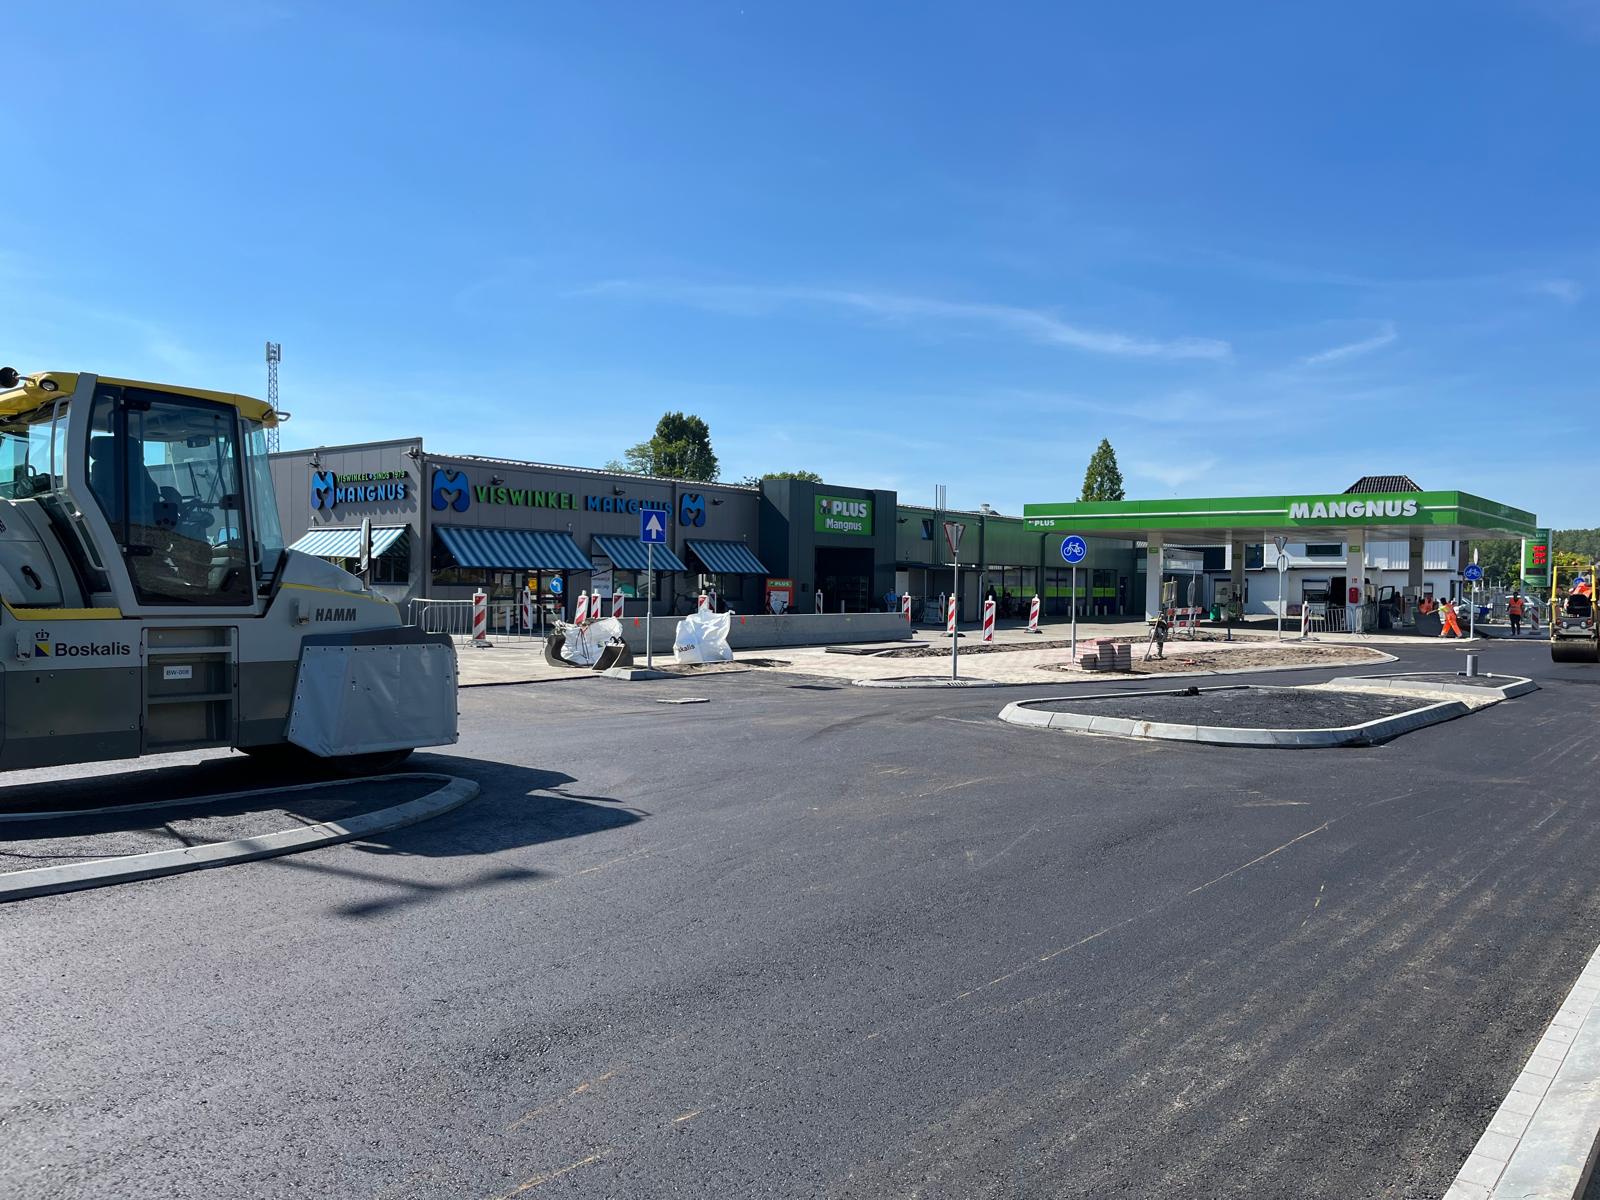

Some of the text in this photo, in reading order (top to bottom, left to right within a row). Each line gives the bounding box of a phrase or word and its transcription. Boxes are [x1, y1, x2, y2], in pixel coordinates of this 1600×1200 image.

[336, 473, 369, 483] VISWINKEL
[336, 482, 405, 503] MANGNUS
[475, 484, 579, 511] VISWINKEL
[831, 500, 868, 518] PLUS
[1289, 499, 1418, 519] MANGNUS
[825, 518, 862, 532] Mangnus
[1034, 519, 1055, 527] PLUS
[315, 608, 357, 622] HAMM
[55, 641, 131, 657] Boskalis
